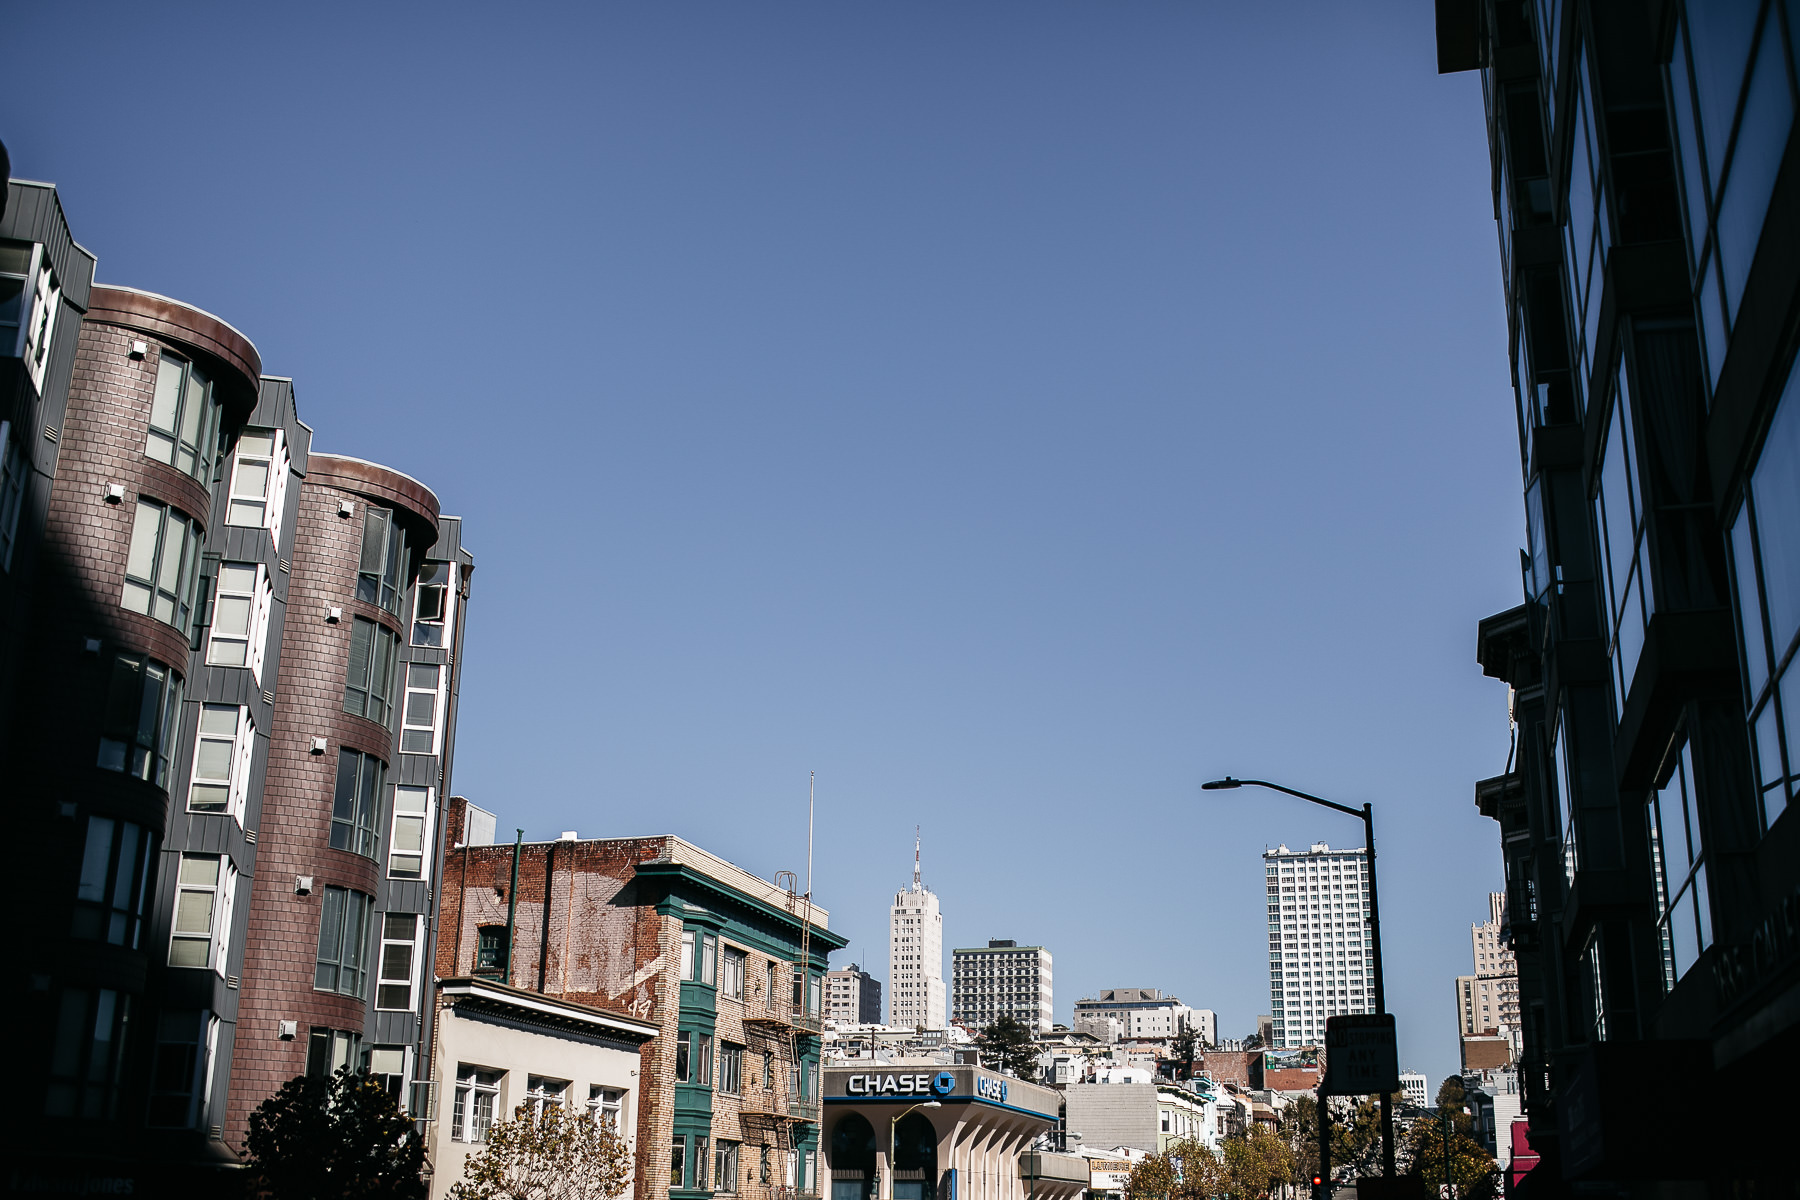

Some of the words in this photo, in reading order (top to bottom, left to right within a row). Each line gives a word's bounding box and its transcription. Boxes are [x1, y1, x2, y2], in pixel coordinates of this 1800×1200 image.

[1348, 1049, 1376, 1062] ANY
[1346, 1063, 1381, 1078] TIME
[848, 1074, 931, 1093] CHASE
[977, 1075, 1002, 1099] CHASE
[1092, 1161, 1130, 1171] LUMIERE
